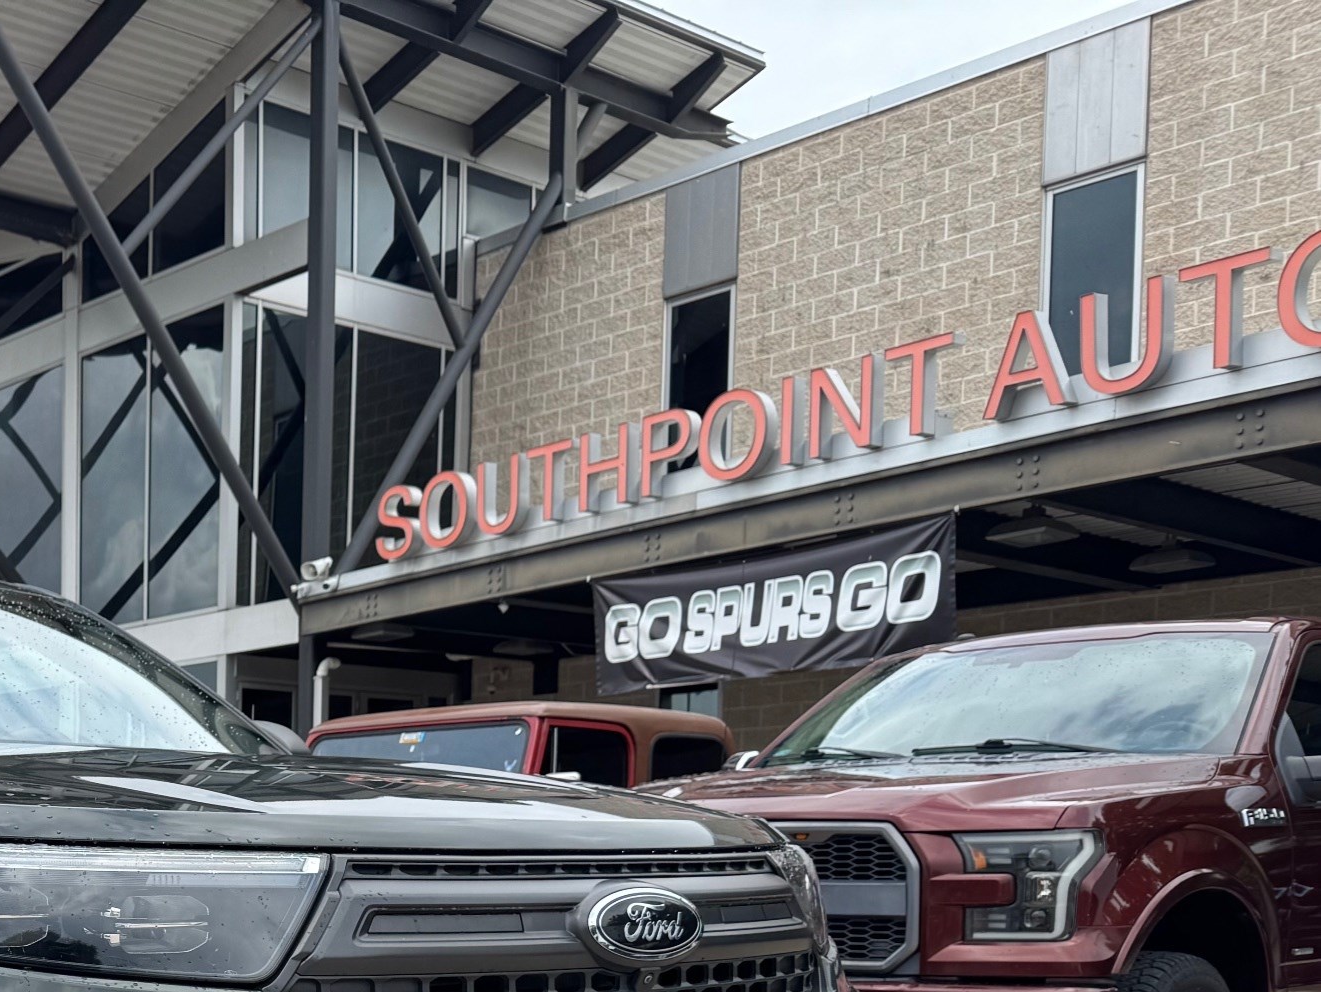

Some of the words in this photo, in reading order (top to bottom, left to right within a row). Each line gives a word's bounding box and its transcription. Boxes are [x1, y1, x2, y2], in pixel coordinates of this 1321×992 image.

[375, 331, 964, 562] SOUTHPOINT
[604, 595, 683, 664] GO
[682, 569, 835, 654] SPURS
[835, 549, 942, 632] GO
[623, 902, 684, 943] Ford
